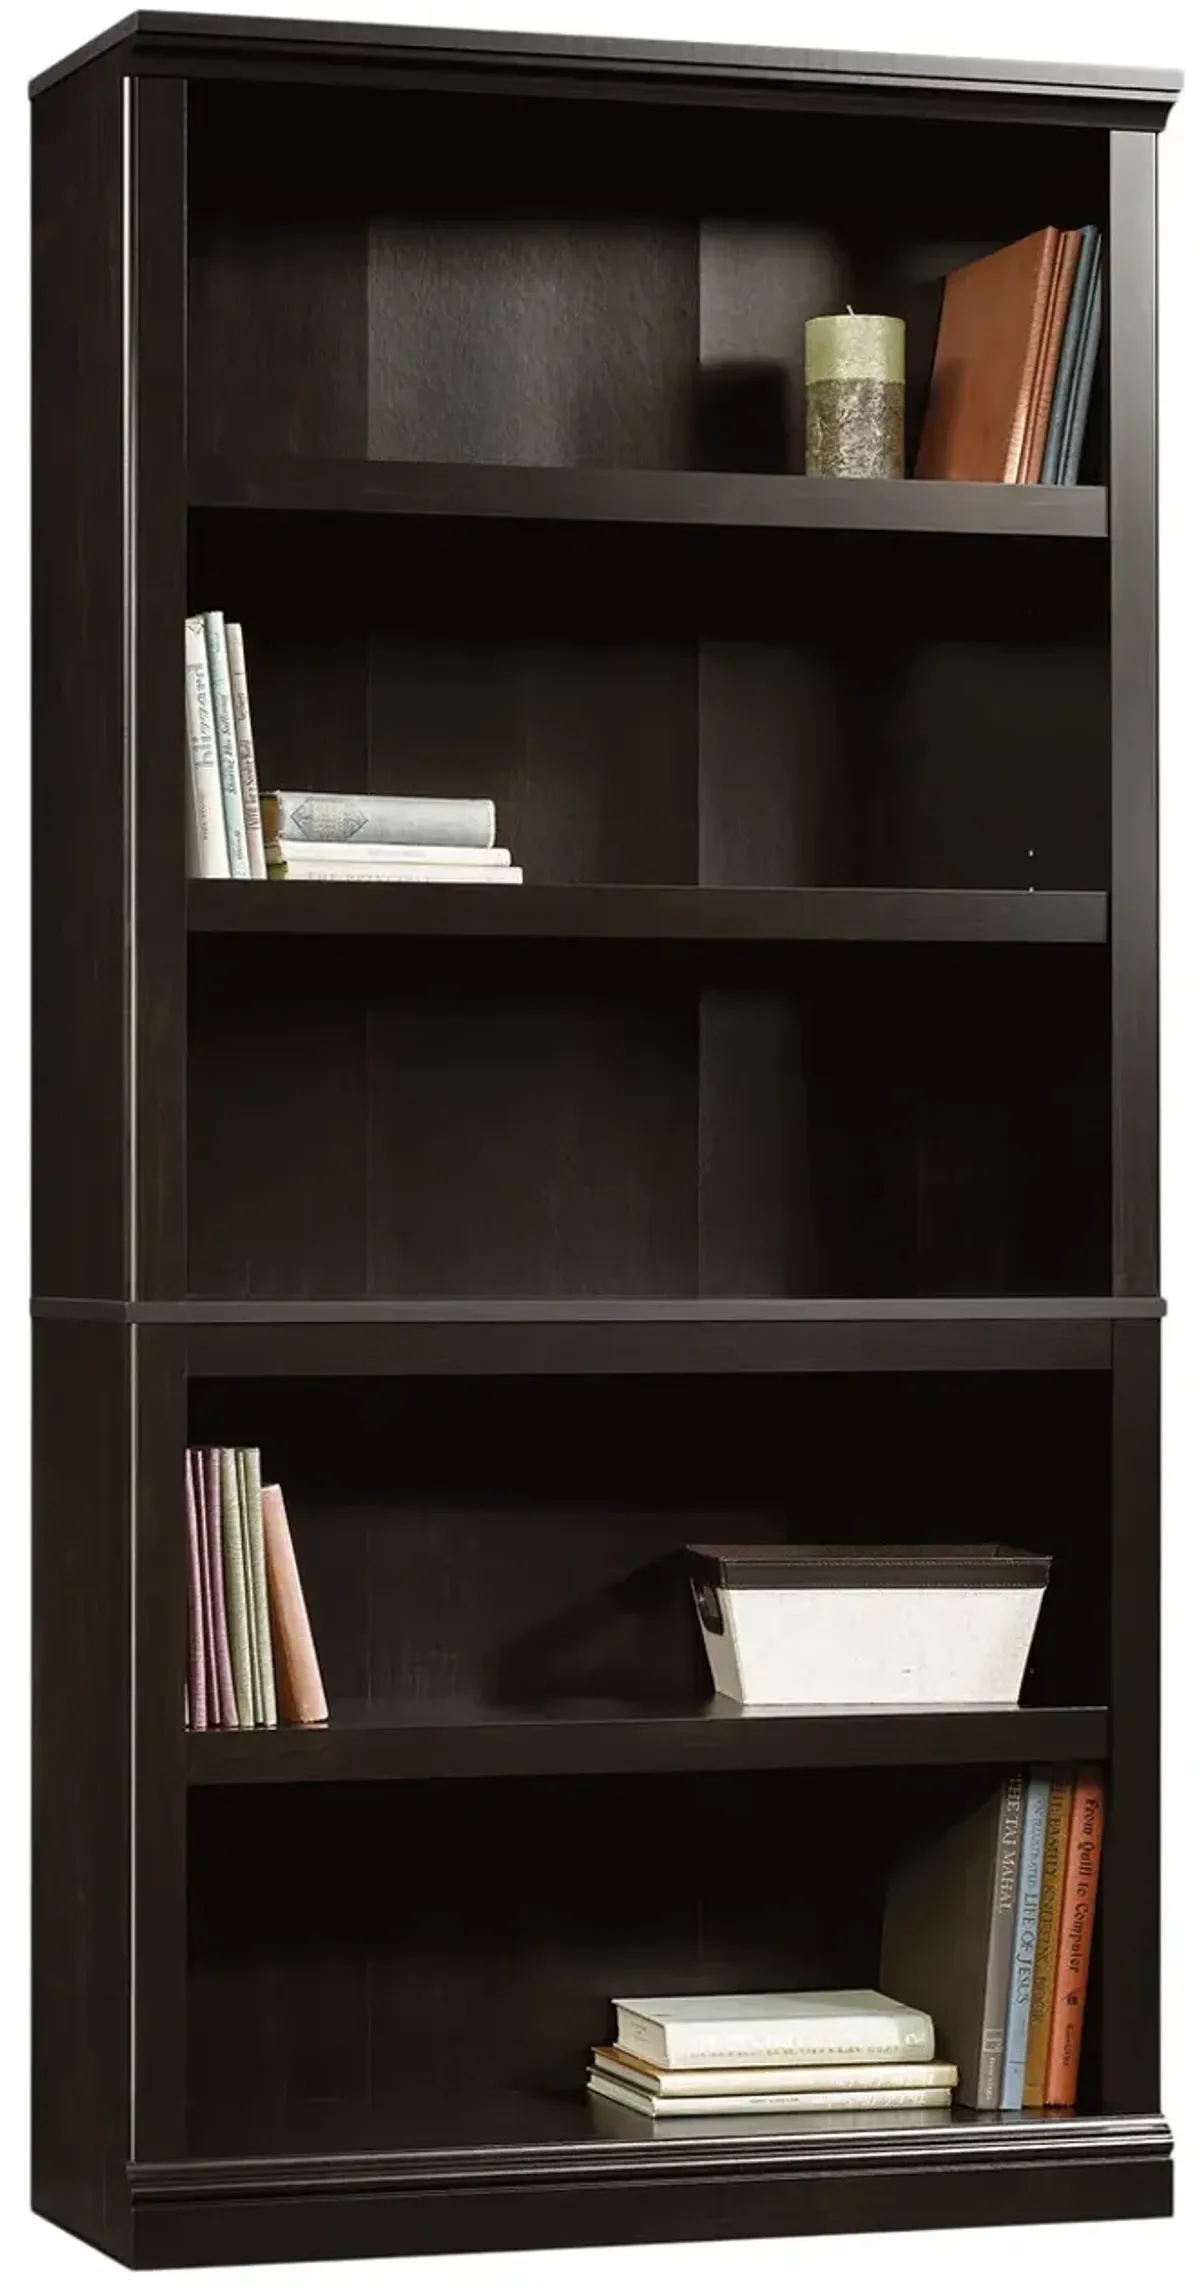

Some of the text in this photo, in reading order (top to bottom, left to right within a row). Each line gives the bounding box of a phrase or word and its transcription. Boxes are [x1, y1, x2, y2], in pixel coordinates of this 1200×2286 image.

[1000, 1770, 1023, 1913] THE TAJ MAHAL
[1022, 1893, 1038, 1926] LIFE
[1069, 1799, 1100, 1973] From Quill to Computer
[1020, 1930, 1035, 1949] OF
[1015, 1954, 1032, 2005] JESUS
